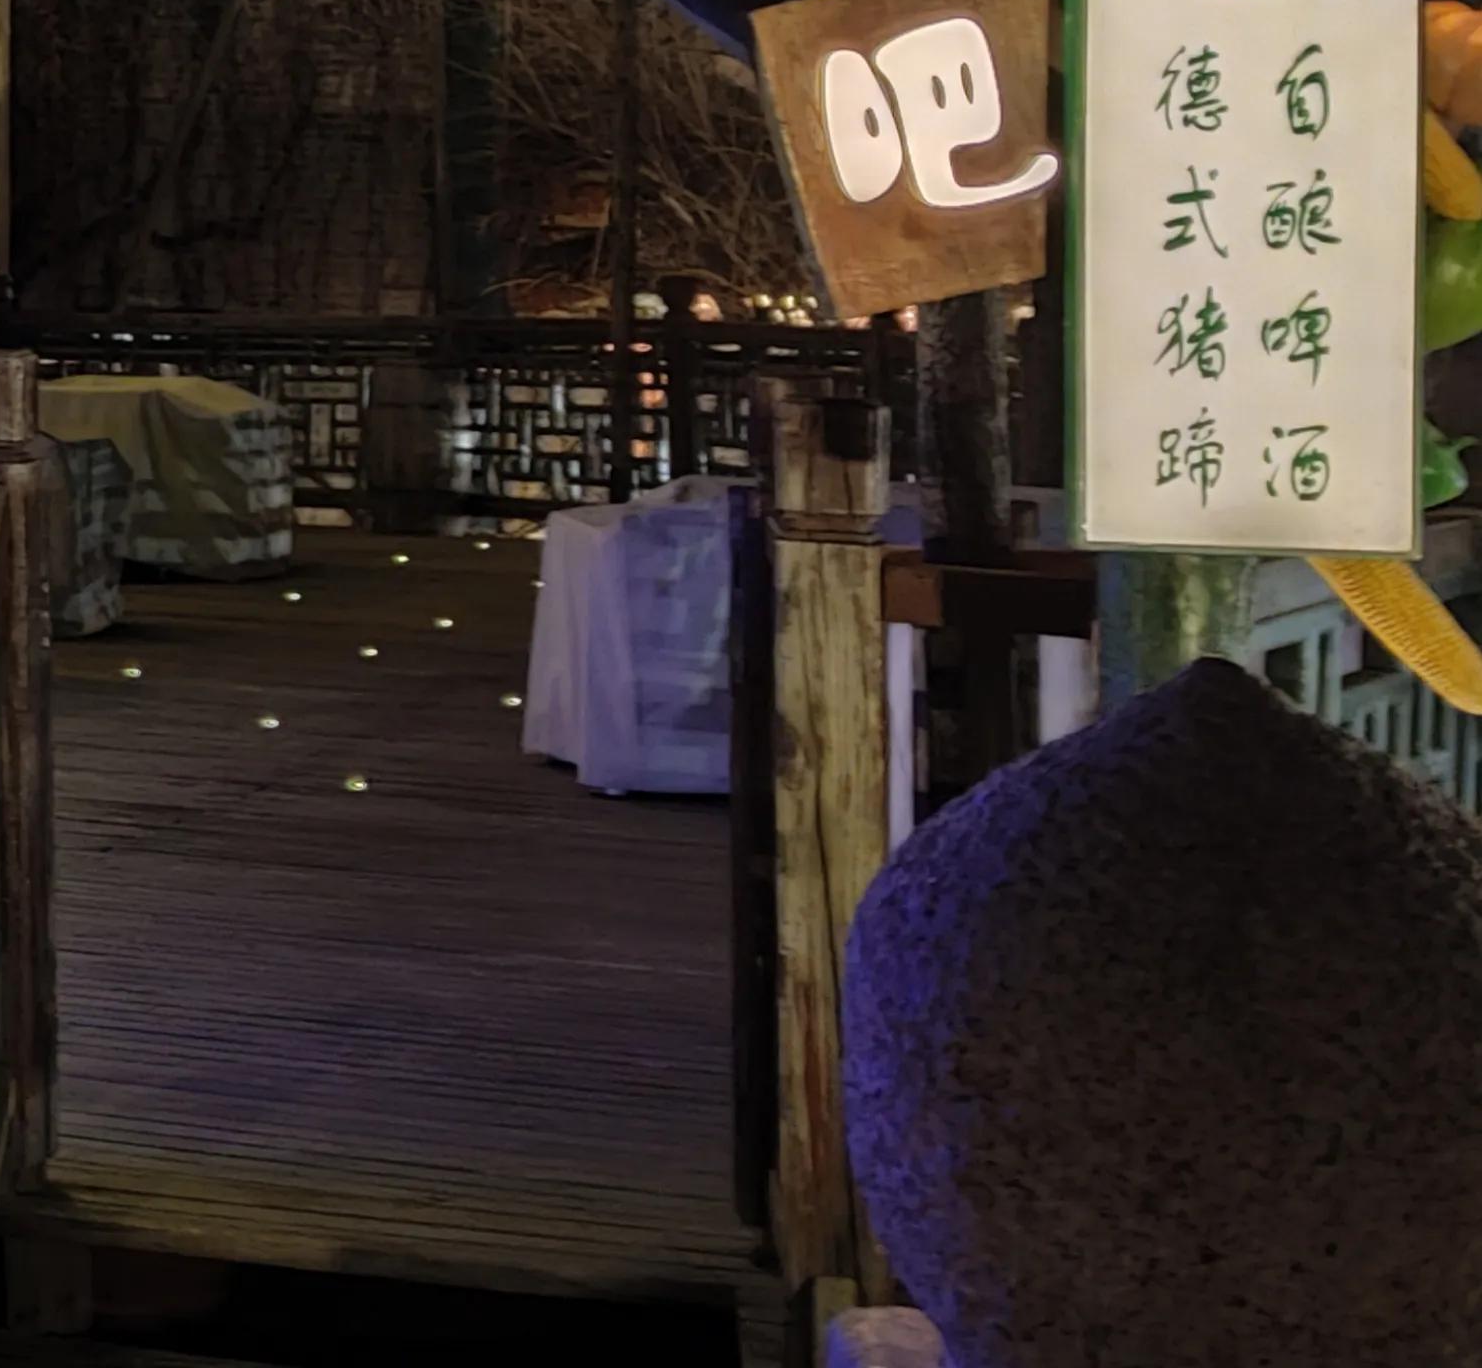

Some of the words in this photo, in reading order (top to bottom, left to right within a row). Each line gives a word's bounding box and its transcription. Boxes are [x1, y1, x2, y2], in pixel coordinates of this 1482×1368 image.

[823, 17, 1059, 209] 吧
[1154, 45, 1230, 508] 德式猪蹄
[1260, 44, 1342, 502] 自酿啤酒
